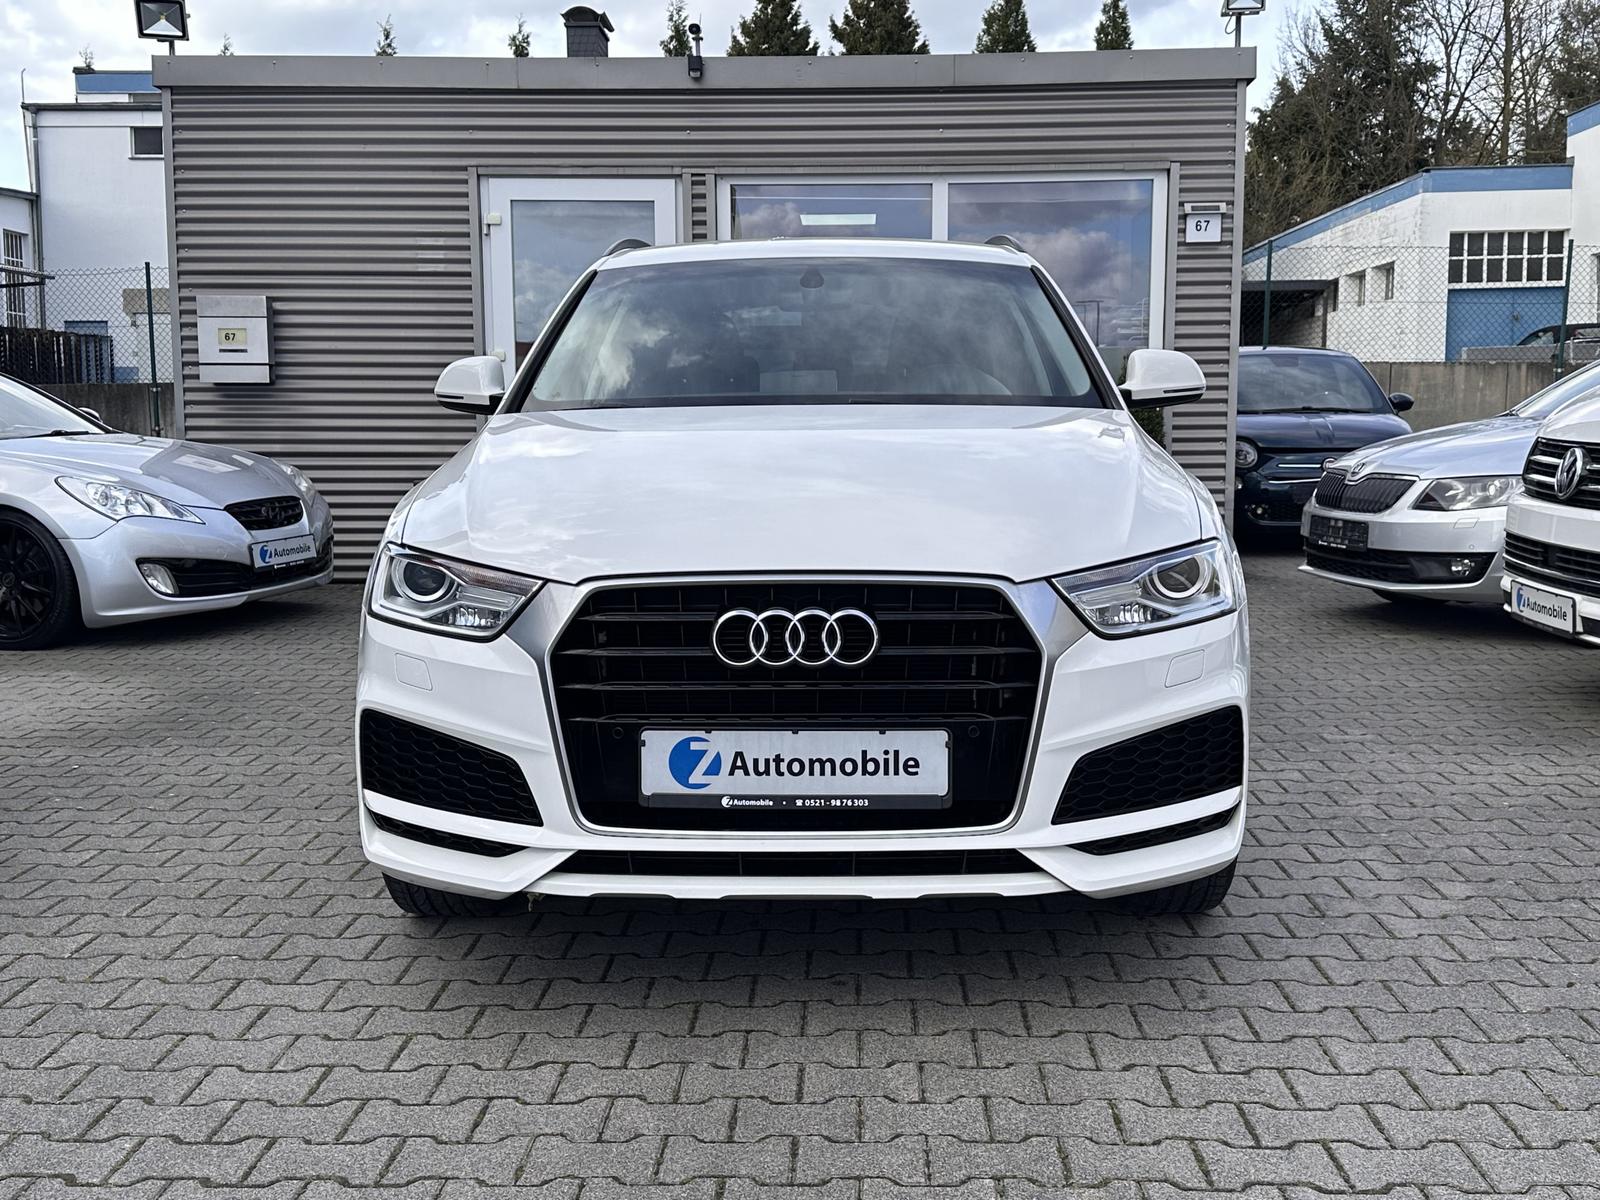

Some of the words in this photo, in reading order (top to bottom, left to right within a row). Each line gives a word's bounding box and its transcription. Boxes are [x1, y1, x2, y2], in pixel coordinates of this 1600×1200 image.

[1195, 219, 1210, 232] 67
[224, 332, 236, 341] 67
[274, 543, 311, 558] Automobile
[1526, 597, 1567, 621] Automobile
[728, 749, 920, 777] Automobile
[733, 798, 774, 807] Automobile
[804, 798, 825, 807] 0521
